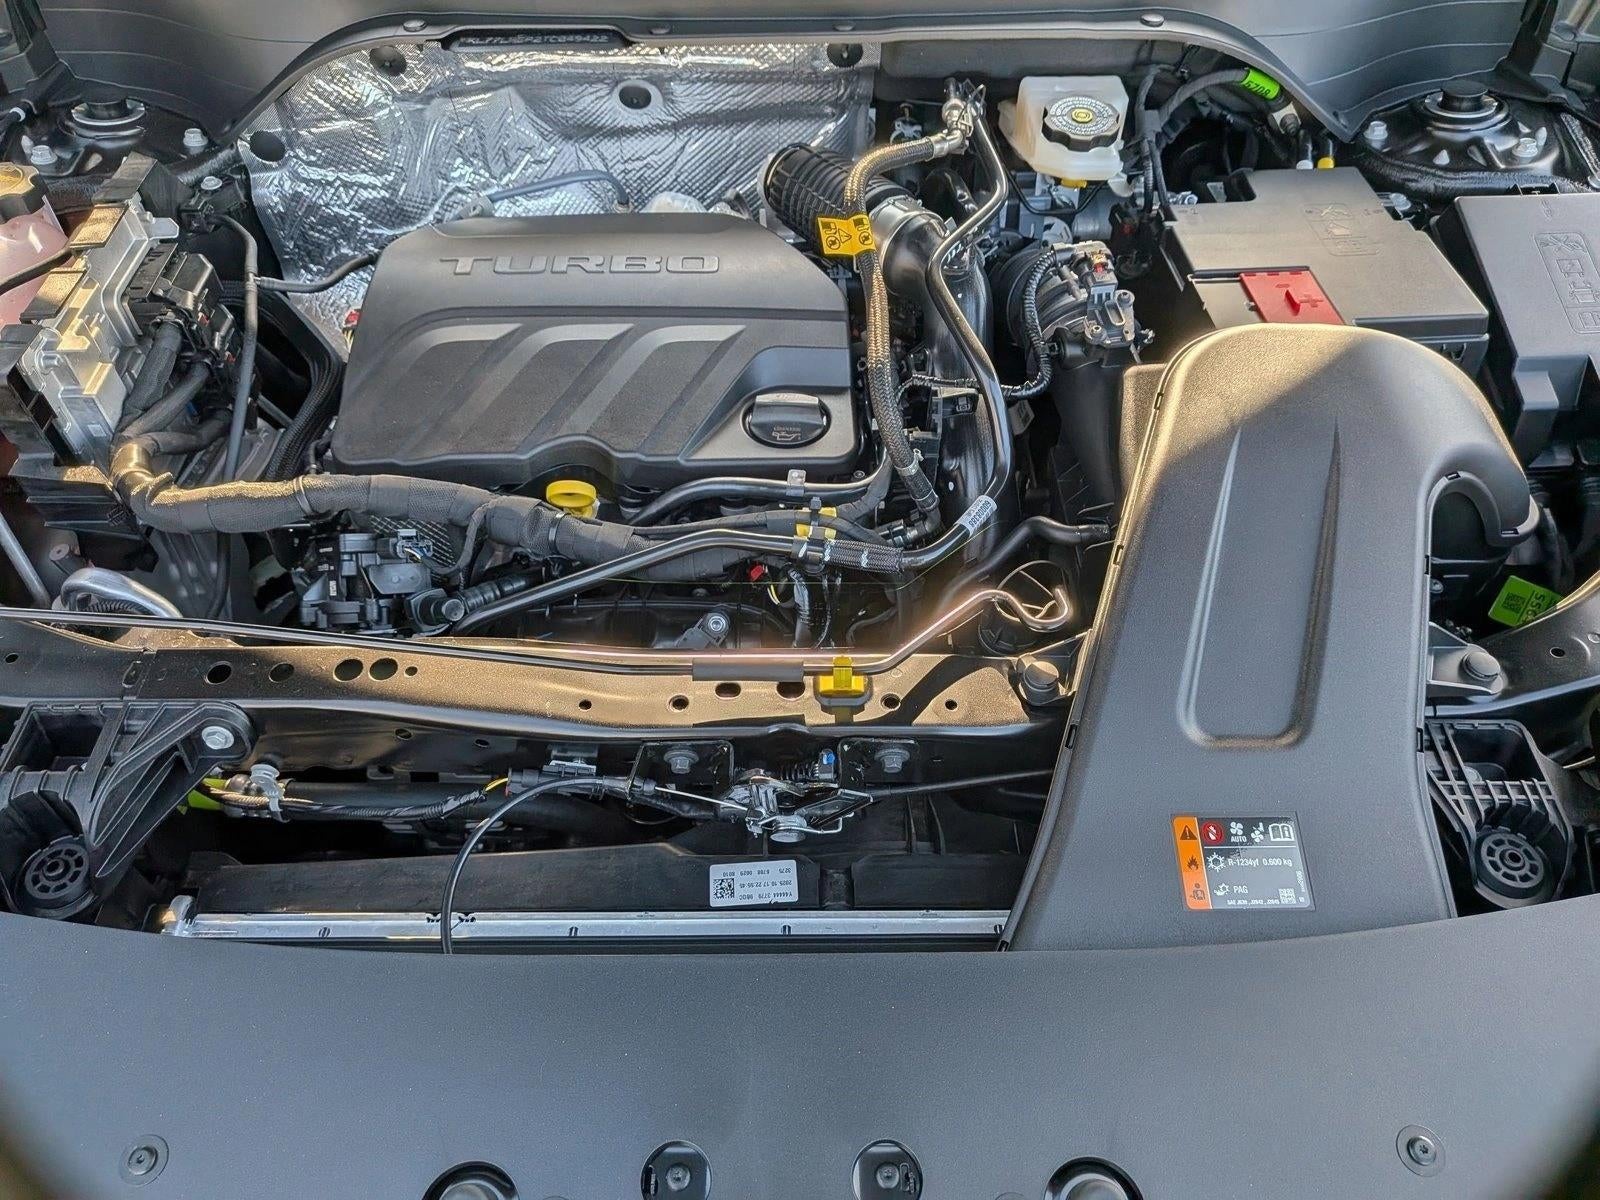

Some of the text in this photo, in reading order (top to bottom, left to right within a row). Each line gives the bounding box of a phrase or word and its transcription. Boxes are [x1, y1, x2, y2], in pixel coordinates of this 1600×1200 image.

[439, 255, 720, 275] TURBO
[1231, 835, 1247, 843] AUTO
[1283, 858, 1293, 868] kg
[1233, 885, 1249, 894] PAG
